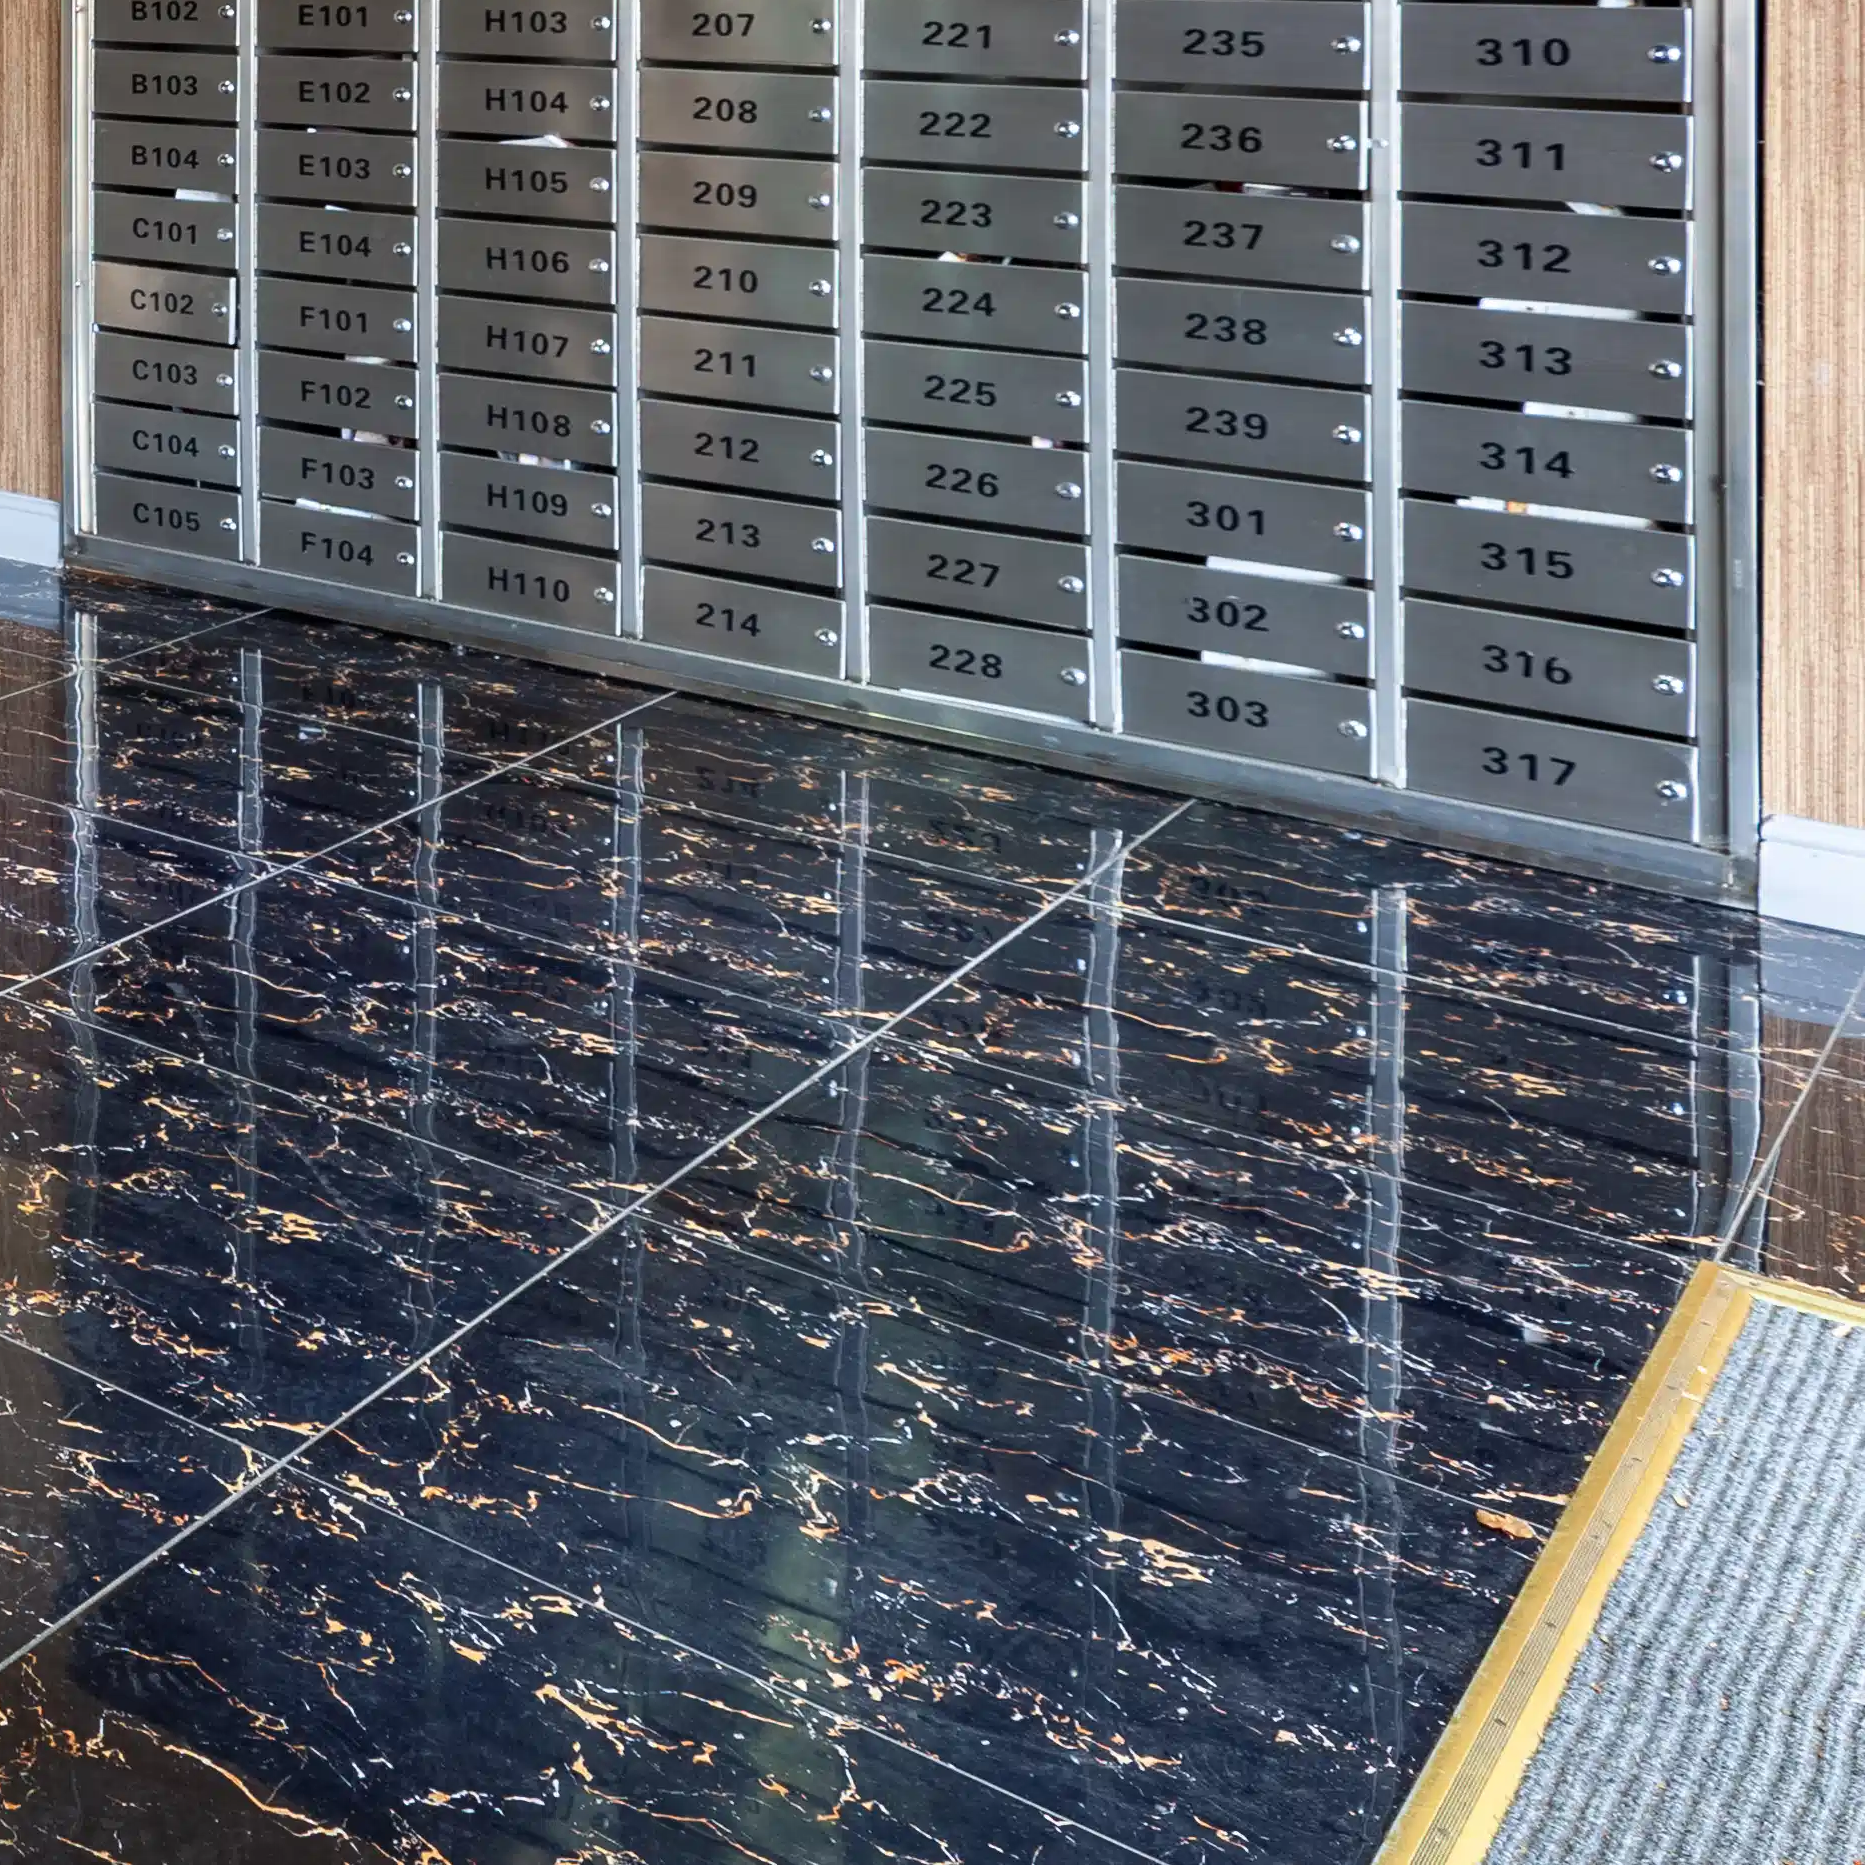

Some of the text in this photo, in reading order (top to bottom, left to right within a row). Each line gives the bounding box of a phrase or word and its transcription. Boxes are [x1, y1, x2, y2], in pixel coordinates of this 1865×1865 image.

[131, 0, 199, 21] B102
[298, 4, 367, 28] E101
[485, 9, 567, 34] H103
[691, 13, 755, 37] 207
[922, 21, 991, 50] 221
[1182, 28, 1265, 58] 235
[1476, 38, 1570, 67] 310
[131, 73, 198, 96] B103
[299, 80, 371, 104] E102
[485, 87, 568, 113] H104
[692, 96, 758, 124] 208
[919, 111, 992, 139] 222
[1180, 122, 1262, 154] 236
[131, 144, 200, 170] B104
[298, 154, 371, 180] E103
[1476, 138, 1564, 171] 311
[485, 167, 568, 194] H105
[692, 181, 757, 209] 209
[920, 199, 992, 228] 223
[132, 217, 197, 245] C101
[299, 230, 372, 258] E104
[1183, 220, 1264, 250] 237
[486, 246, 569, 274] H106
[1477, 239, 1571, 274] 312
[693, 265, 758, 294] 210
[130, 288, 195, 316] C102
[922, 287, 996, 317] 224
[300, 305, 367, 334] F101
[1184, 313, 1267, 346] 238
[486, 325, 569, 358] H107
[132, 359, 198, 386] C103
[694, 348, 755, 378] 211
[1479, 340, 1572, 376] 313
[300, 380, 371, 409] F102
[924, 374, 997, 407] 225
[486, 404, 571, 438] H108
[1185, 406, 1268, 440] 239
[132, 429, 200, 458] C104
[694, 432, 760, 464] 212
[301, 457, 375, 490] F103
[1479, 441, 1574, 479] 314
[925, 463, 999, 498] 226
[487, 483, 568, 517] H109
[132, 502, 200, 532] C105
[1186, 500, 1264, 536] 301
[695, 518, 760, 548] 213
[301, 531, 374, 567] F104
[1480, 541, 1574, 579] 315
[488, 566, 570, 603] H110
[926, 554, 1000, 588] 227
[696, 602, 761, 637] 214
[1187, 596, 1270, 632] 302
[929, 644, 1002, 679] 228
[1482, 644, 1572, 685] 316
[1186, 691, 1268, 728] 303
[1482, 746, 1576, 786] 317
